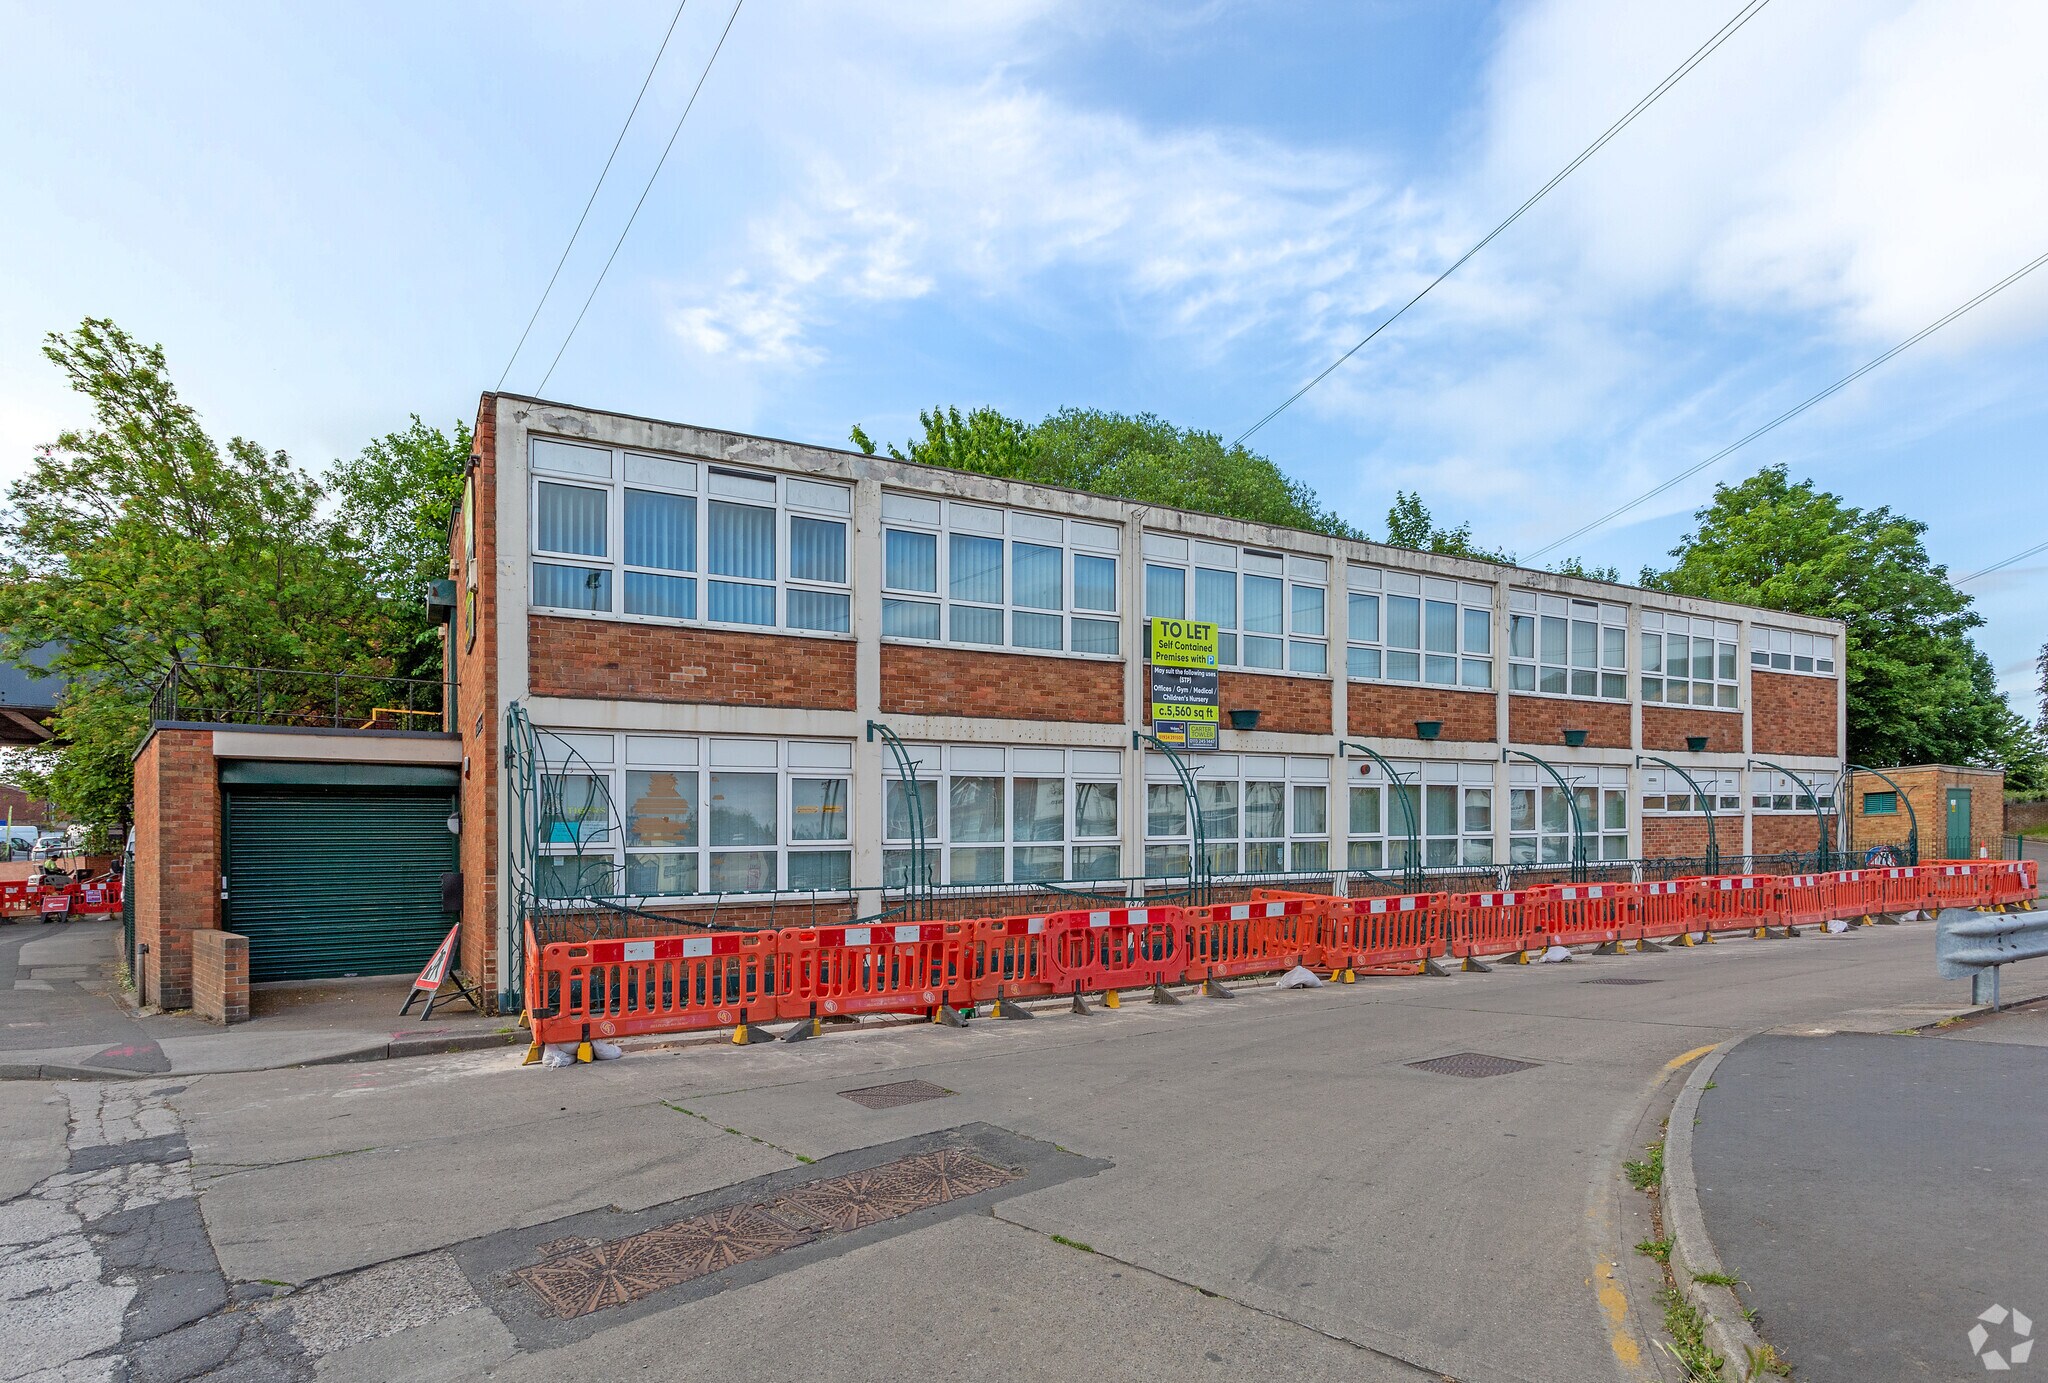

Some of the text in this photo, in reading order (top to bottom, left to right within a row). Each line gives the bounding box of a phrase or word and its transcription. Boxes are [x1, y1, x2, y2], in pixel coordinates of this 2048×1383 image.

[1160, 621, 1211, 640] TO LET
[1158, 639, 1213, 652] Self Contained
[1156, 651, 1190, 662] Premises
[1190, 654, 1206, 664] with
[1183, 669, 1205, 677] following
[1179, 676, 1192, 684] (STP)
[1153, 684, 1172, 692] Offices
[1176, 686, 1189, 694] Gym
[1162, 693, 1209, 704] Children's Nursery
[1158, 705, 1213, 720] c.5,560 sq ft
